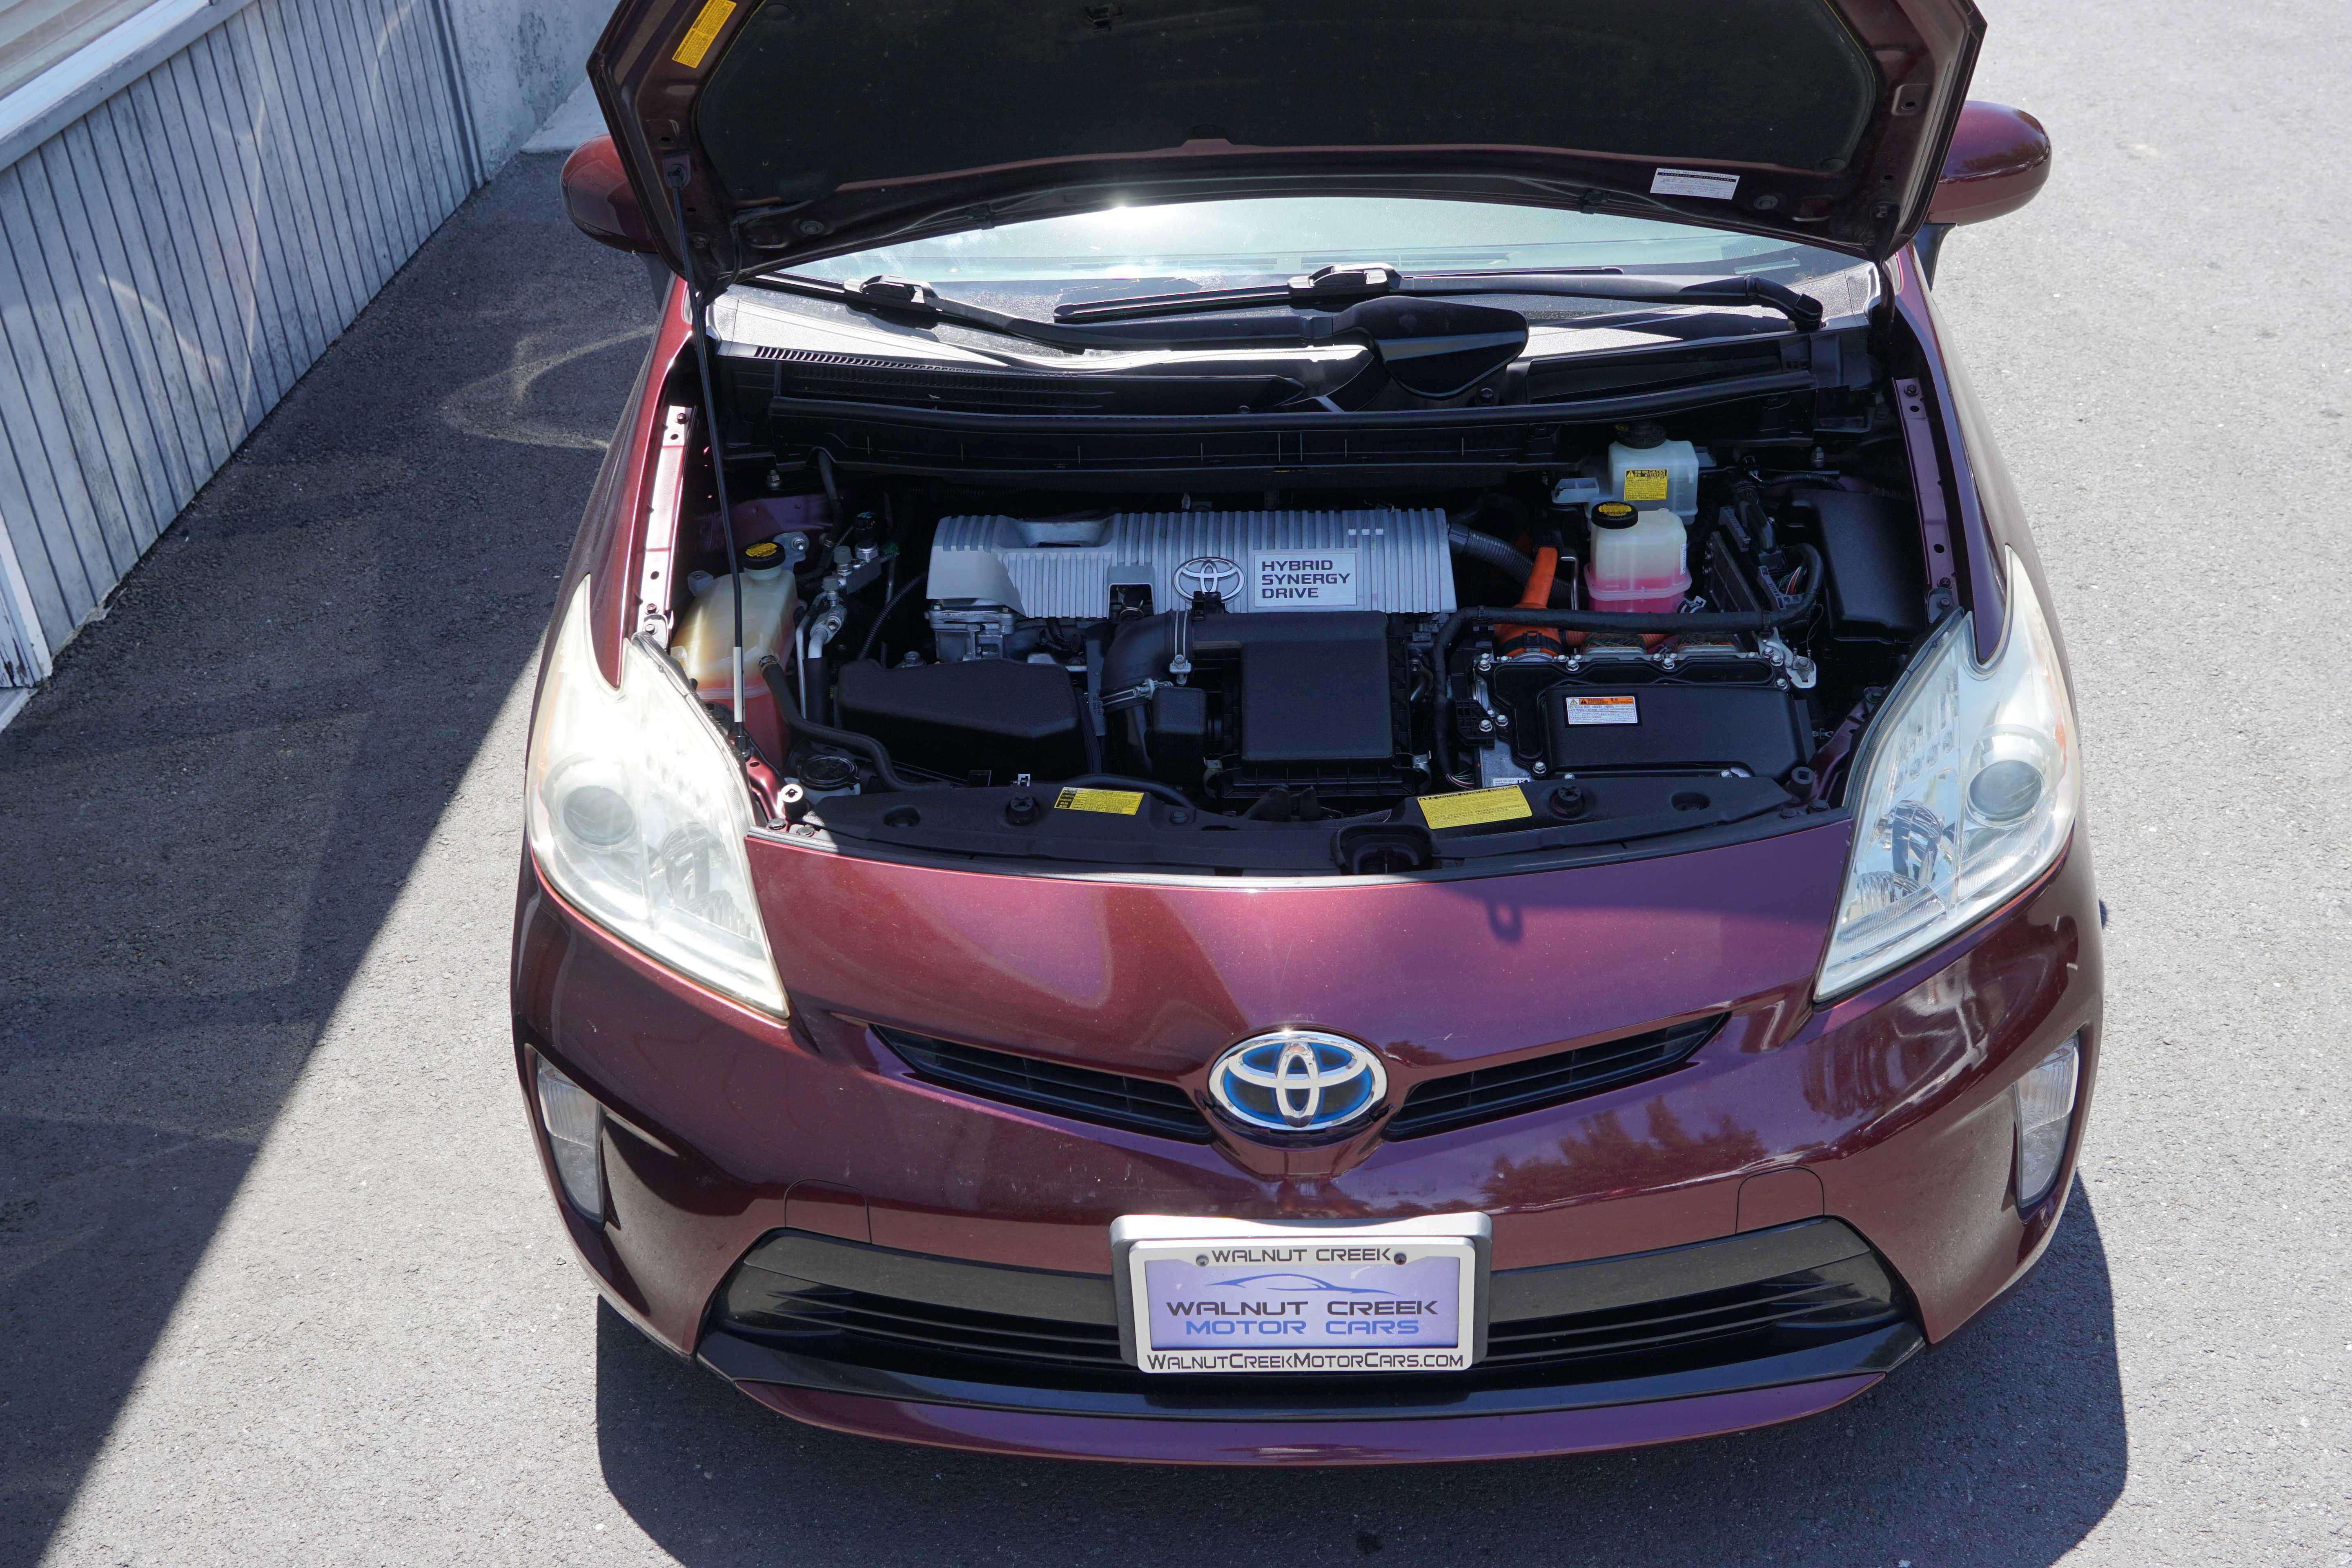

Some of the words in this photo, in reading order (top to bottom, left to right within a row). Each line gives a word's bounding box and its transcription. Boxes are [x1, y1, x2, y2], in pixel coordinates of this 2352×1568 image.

[1262, 560, 1333, 571] HYBRID
[1262, 573, 1350, 585] SYNERGY
[1262, 588, 1319, 599] DRIVE
[1212, 1249, 1307, 1263] WALNUT
[1316, 1248, 1391, 1261] CREEK
[1166, 1301, 1308, 1316] WALNUT
[1327, 1301, 1438, 1316] CREEK
[1185, 1320, 1306, 1335] MOTOR
[1325, 1320, 1419, 1335] CARS
